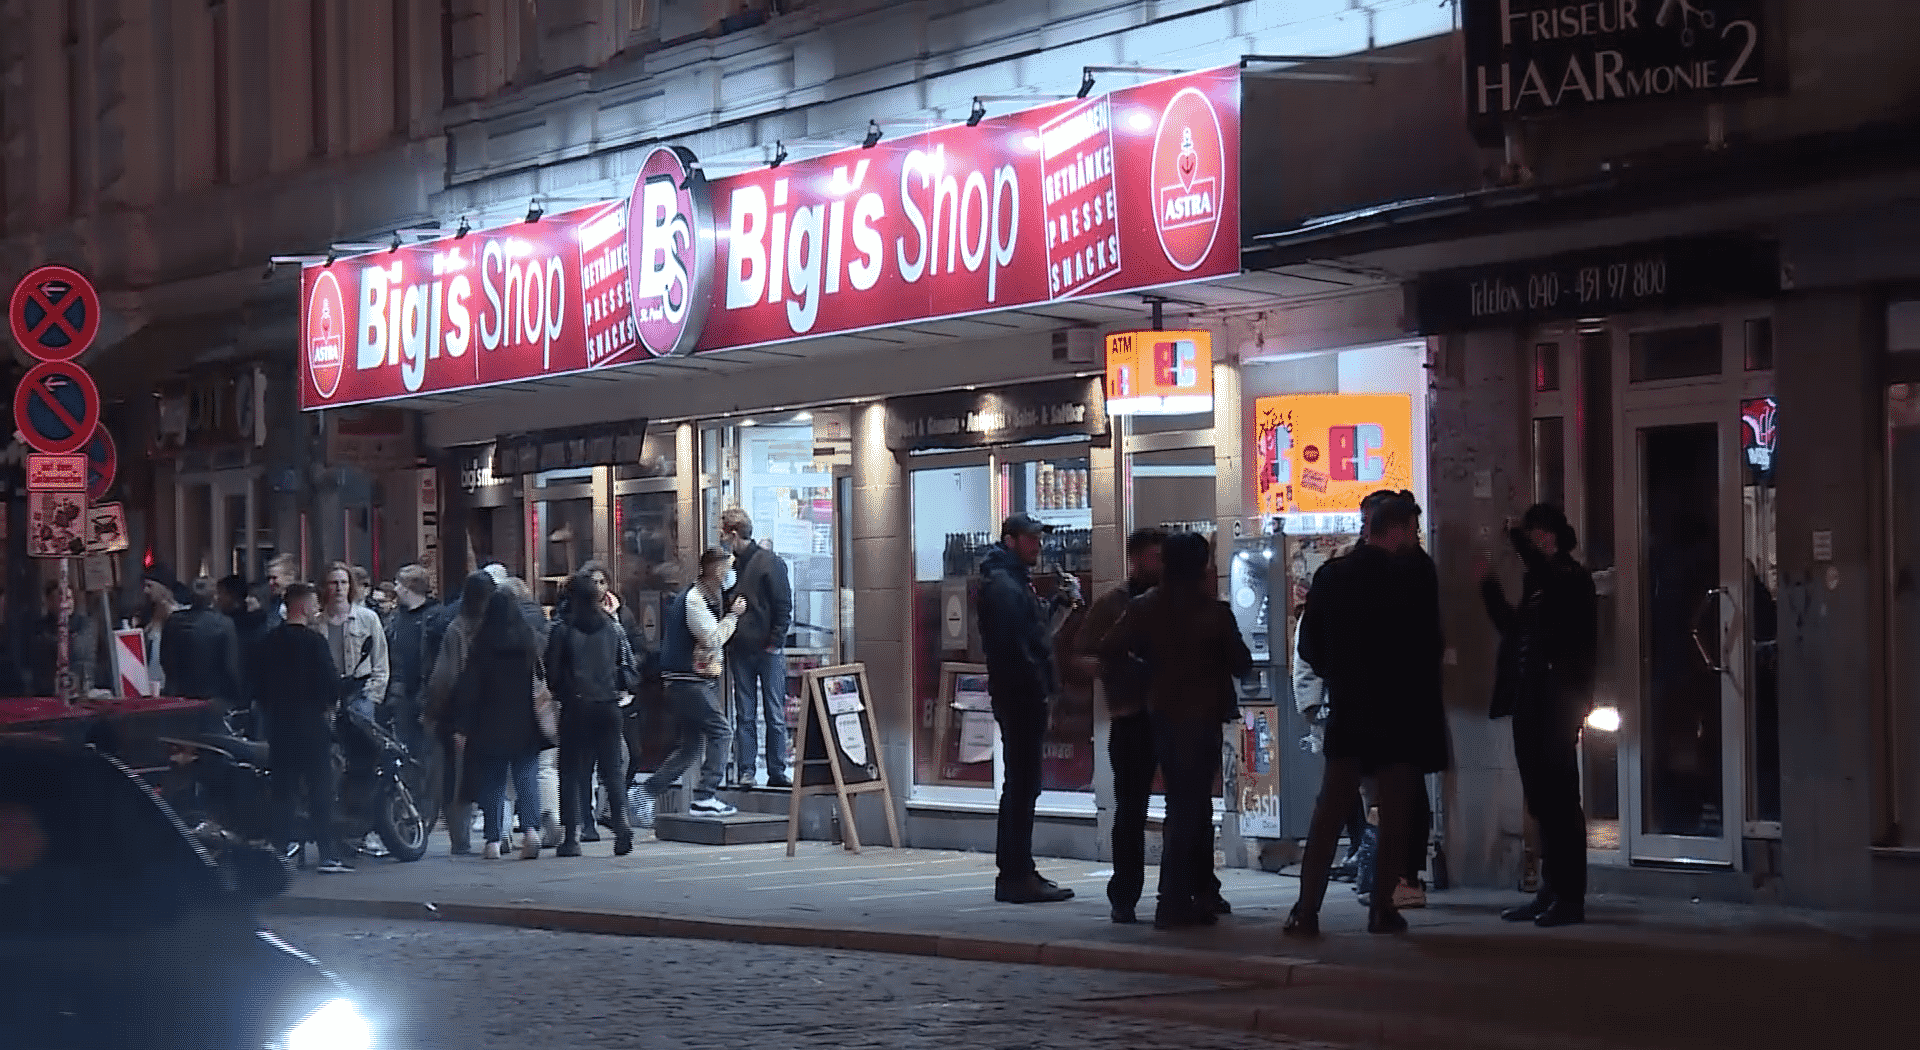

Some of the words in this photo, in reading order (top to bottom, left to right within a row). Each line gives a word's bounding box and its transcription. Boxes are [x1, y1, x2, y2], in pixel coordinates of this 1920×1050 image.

[1045, 146, 1111, 206] GETRÄNKE
[1049, 189, 1114, 249] PRESSE
[1165, 191, 1212, 222] ASTRA
[726, 158, 885, 332] Bigi's
[897, 146, 1019, 303] Shop
[1051, 234, 1118, 293] SNACKS
[480, 237, 565, 370] Shop
[1528, 272, 1559, 310] 040
[1574, 267, 1600, 304] 431
[1607, 263, 1628, 299] 97
[1633, 260, 1667, 298] 800
[588, 315, 634, 362] SNACKS
[1112, 336, 1131, 354] ATM
[1242, 785, 1280, 817] Cash
